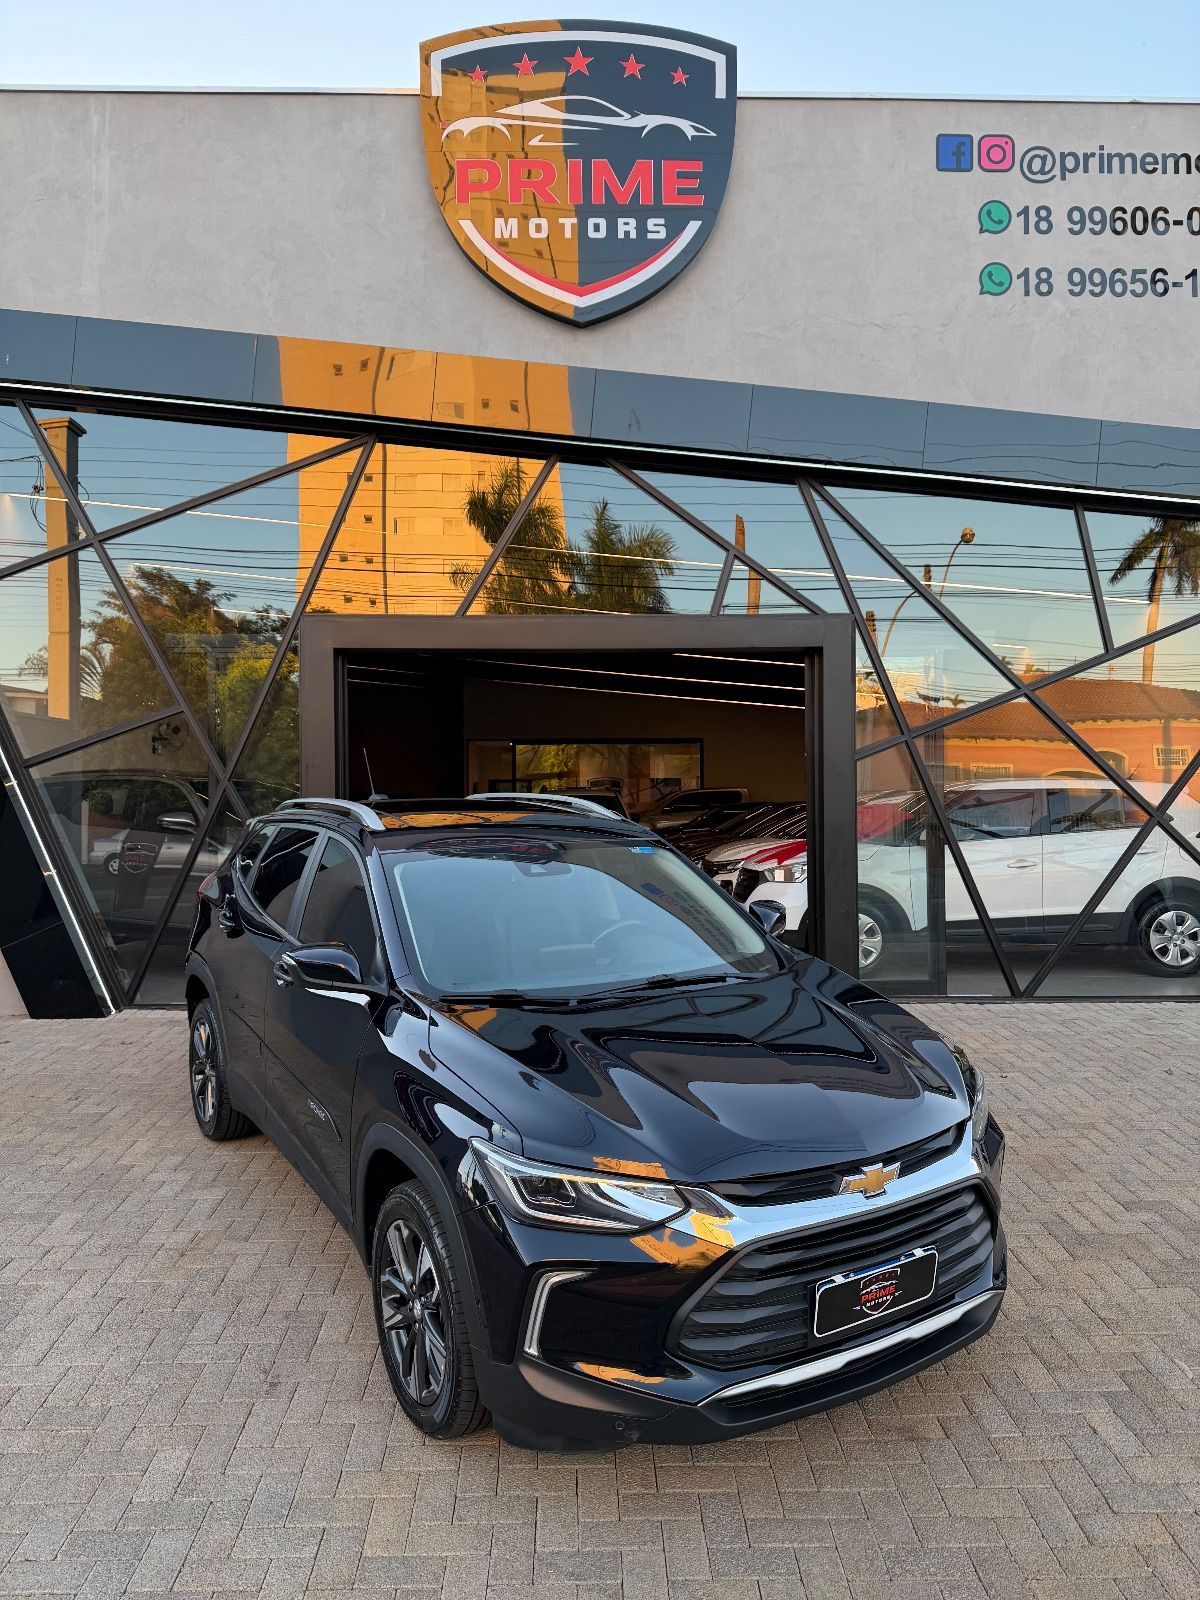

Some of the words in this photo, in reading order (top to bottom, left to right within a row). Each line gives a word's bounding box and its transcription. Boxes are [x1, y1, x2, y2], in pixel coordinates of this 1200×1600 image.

[1020, 144, 1200, 184] @primem
[455, 158, 704, 206] PRIME
[494, 217, 667, 240] MOTORS
[1016, 205, 1054, 236] 18
[1066, 205, 1200, 236] 99606-0
[1016, 267, 1054, 297] 18
[1067, 267, 1198, 298] 99656-1
[861, 1285, 896, 1304] PRIME
